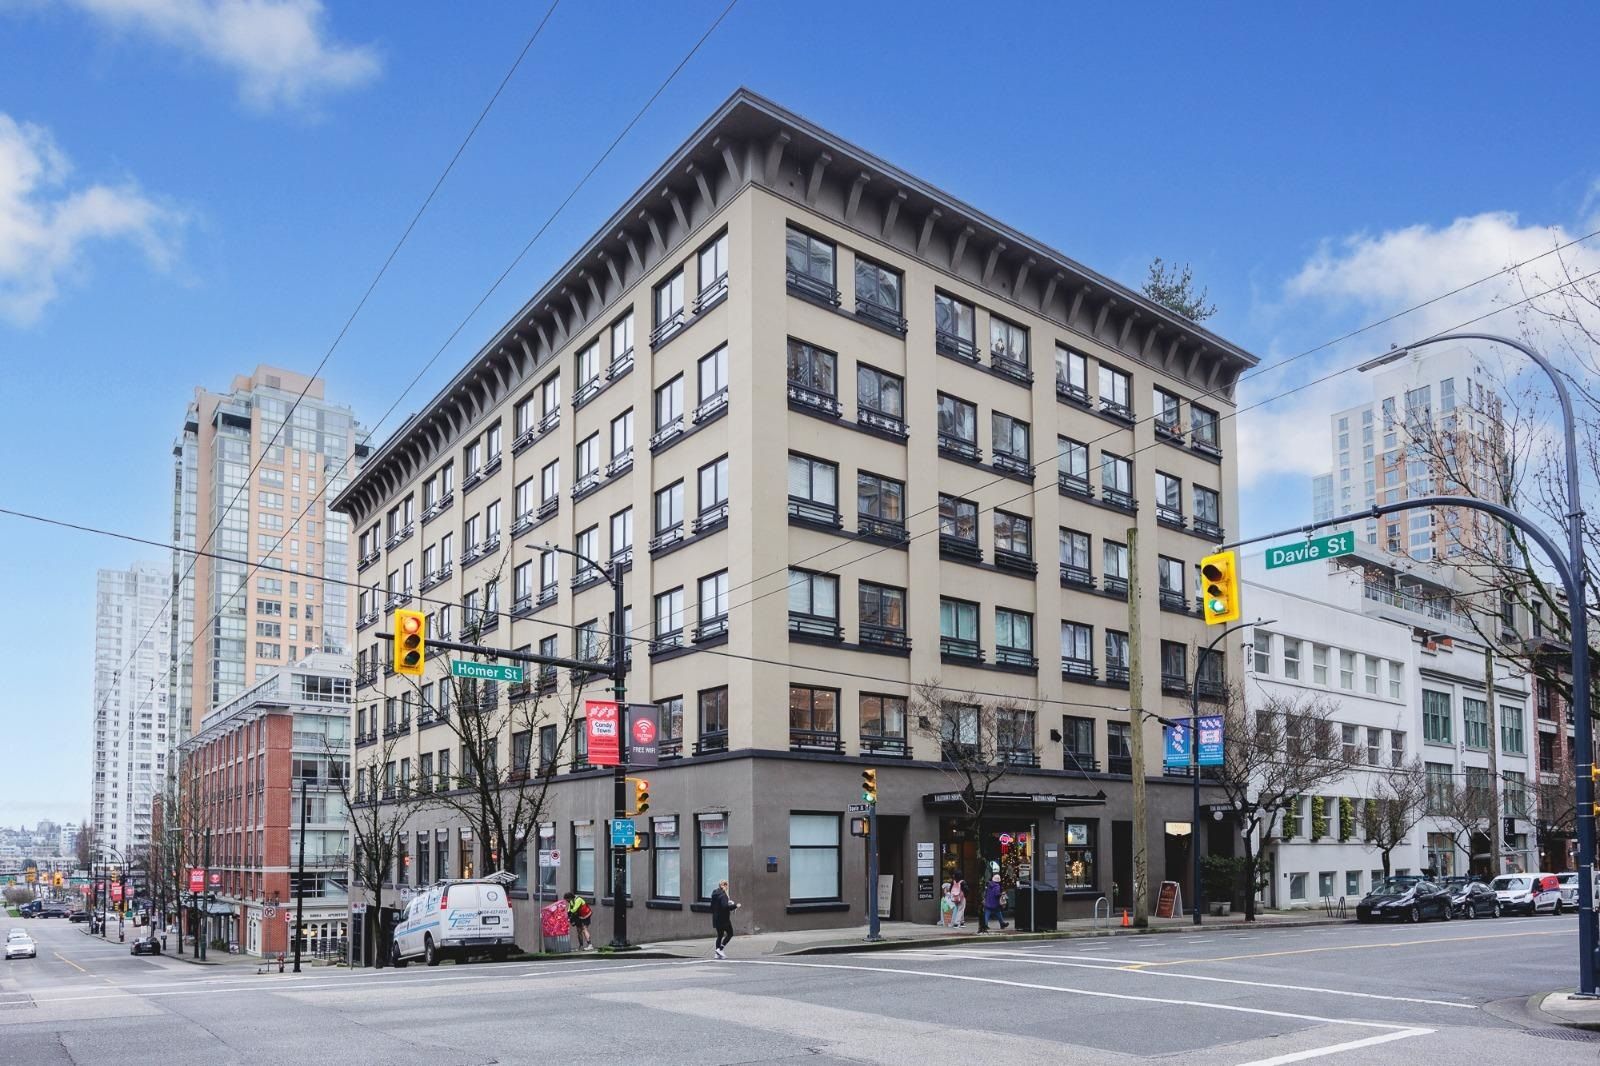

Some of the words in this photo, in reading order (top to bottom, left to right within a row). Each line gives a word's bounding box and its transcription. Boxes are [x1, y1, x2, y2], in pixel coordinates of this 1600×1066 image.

[1273, 541, 1319, 565] Davie
[1327, 537, 1347, 554] St
[458, 663, 499, 678] Homer
[504, 668, 518, 680] St
[594, 721, 613, 729] Candy
